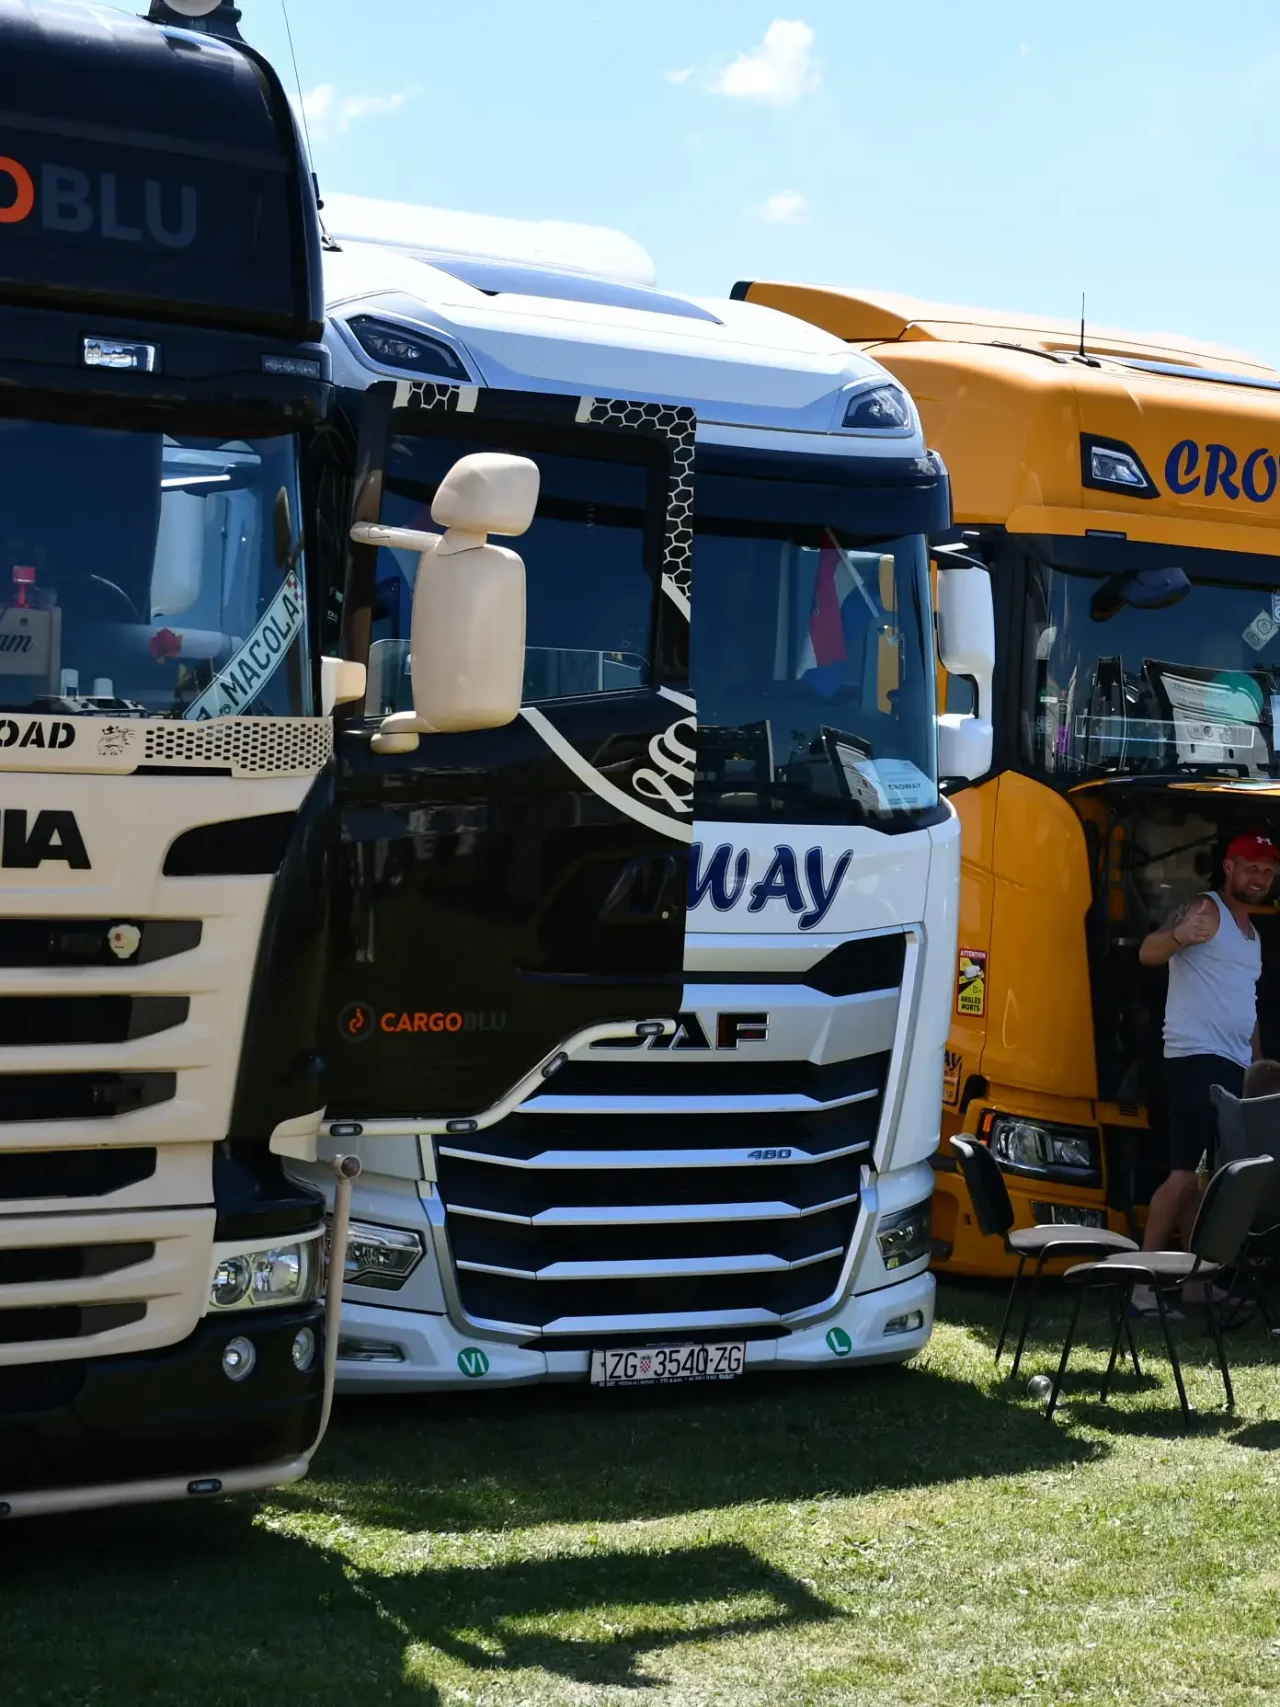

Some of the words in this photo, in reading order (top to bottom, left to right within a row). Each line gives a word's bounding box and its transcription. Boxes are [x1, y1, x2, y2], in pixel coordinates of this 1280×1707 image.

[219, 593, 300, 707] MACOLA
[960, 950, 986, 959] ATTENTION
[960, 996, 981, 1004] ANGLES
[961, 1003, 980, 1012] MORTS
[747, 1147, 792, 1160] 480
[609, 1352, 637, 1380] ZG
